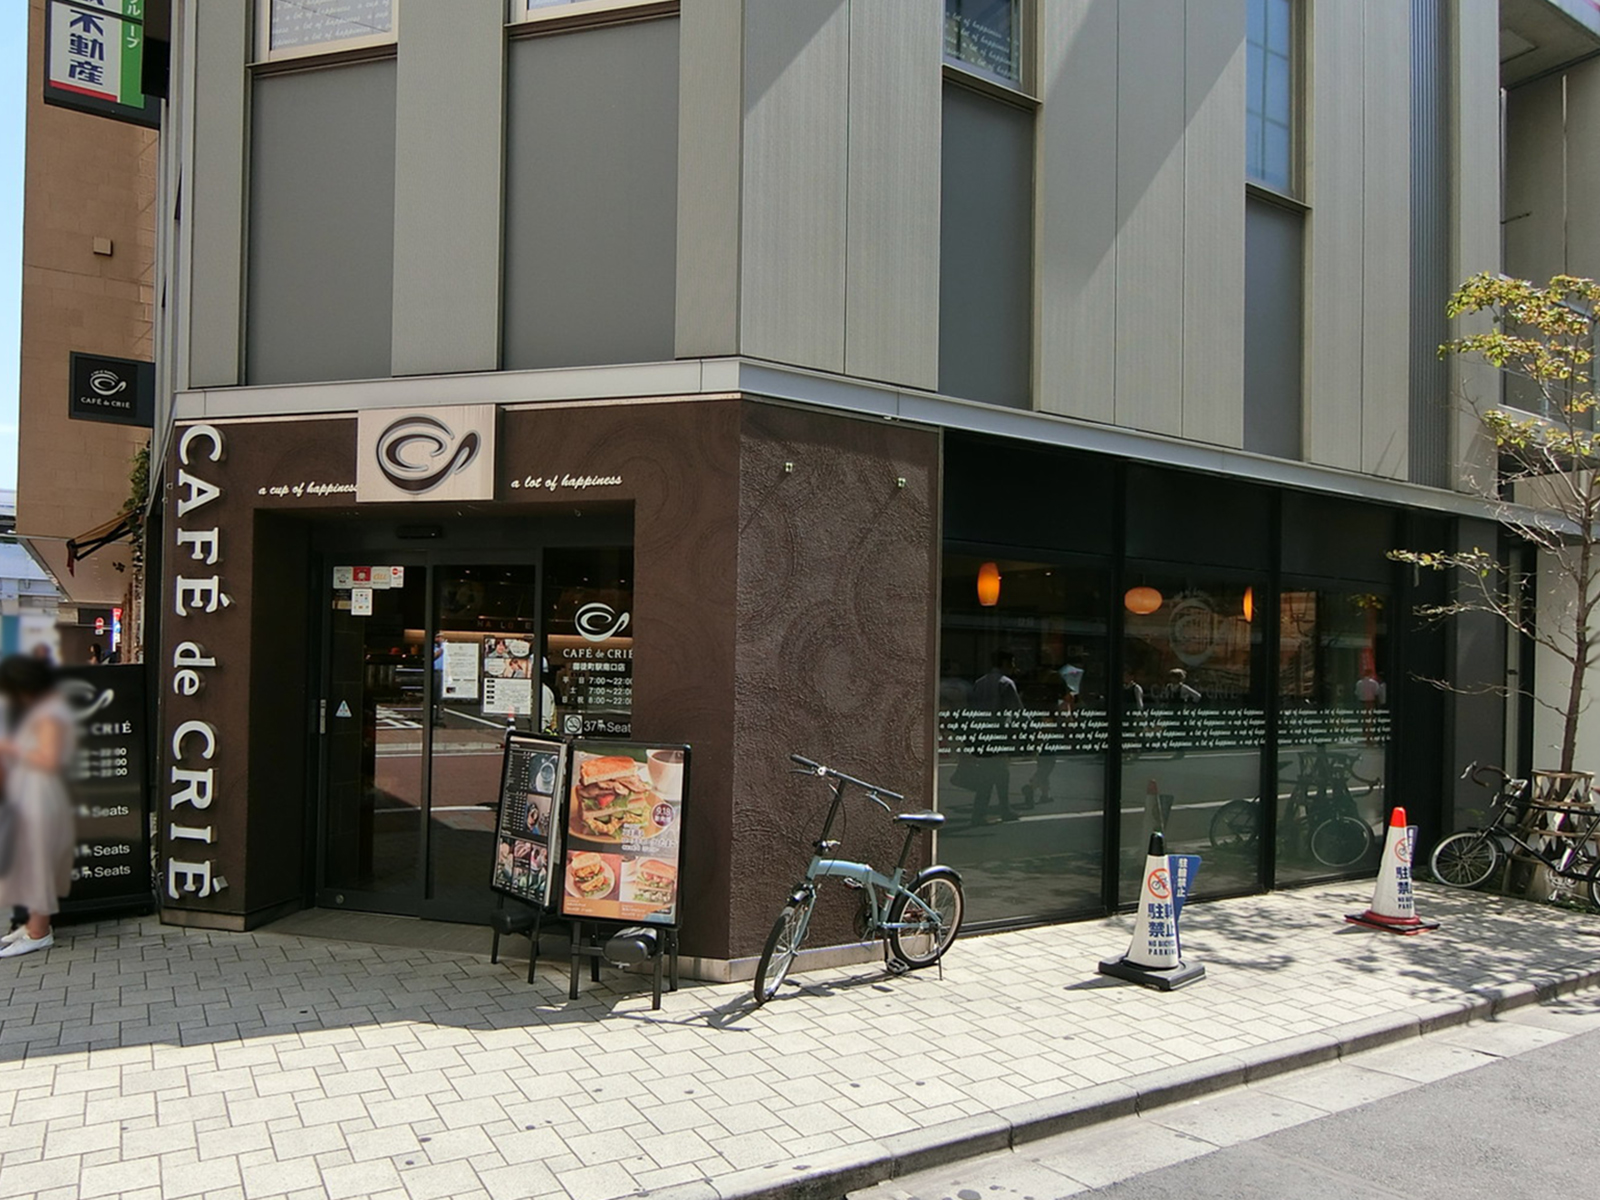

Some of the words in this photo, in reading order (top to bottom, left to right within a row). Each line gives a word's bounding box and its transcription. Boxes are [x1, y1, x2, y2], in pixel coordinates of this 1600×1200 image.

[69, 0, 104, 86] 不動産
[258, 486, 267, 495] a
[269, 484, 290, 497] cup
[292, 482, 305, 497] of
[510, 480, 520, 488] a
[524, 476, 542, 488] lot
[544, 475, 558, 492] of
[561, 474, 622, 490] happiness
[176, 424, 232, 616] CAFÉ
[563, 647, 593, 658] CAFÉ
[174, 640, 216, 696] de
[584, 720, 597, 732] 37
[92, 806, 129, 818] Seats
[168, 720, 228, 899] CRIÉ
[93, 844, 130, 857] Seats
[94, 864, 131, 878] Seats
[1396, 866, 1410, 879] 駐
[1397, 882, 1412, 894] 禁
[1148, 921, 1174, 937] 禁止
